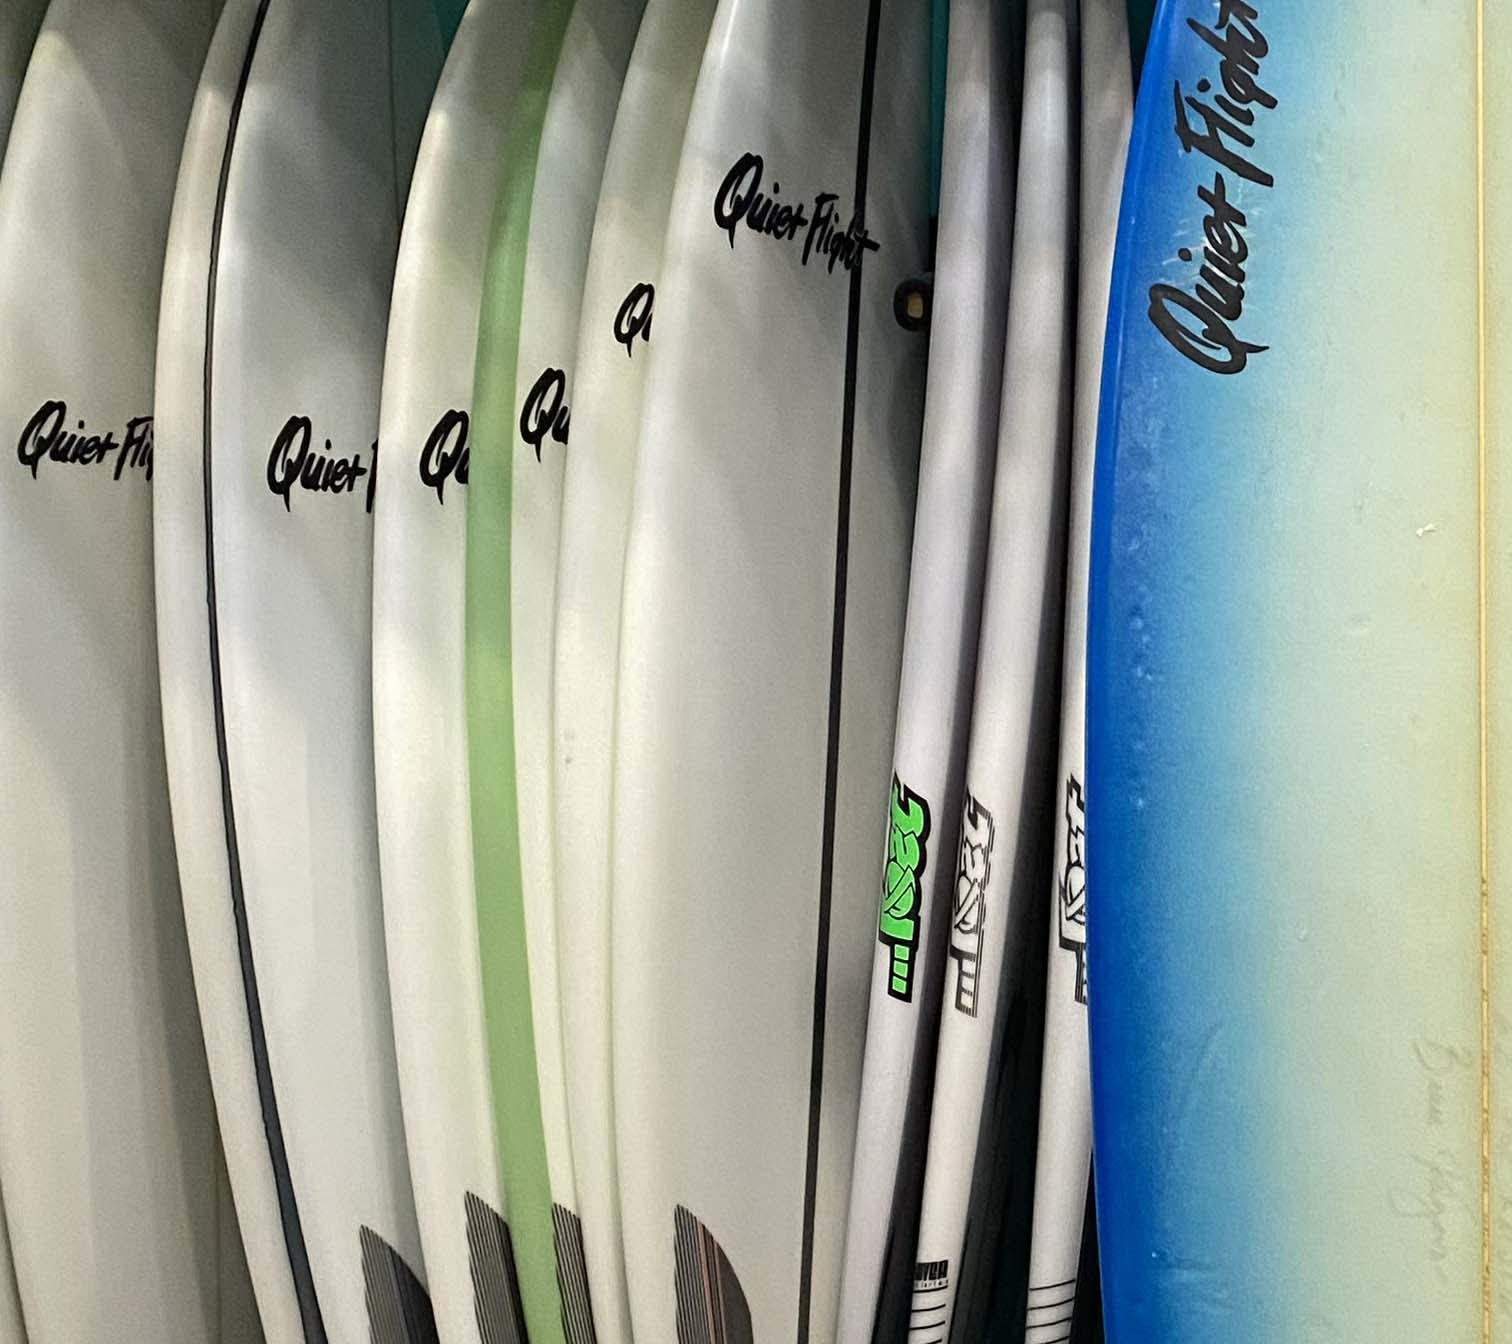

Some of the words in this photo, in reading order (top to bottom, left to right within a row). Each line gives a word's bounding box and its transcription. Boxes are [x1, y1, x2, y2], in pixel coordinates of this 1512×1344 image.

[714, 152, 808, 249] Quiet
[802, 192, 881, 275] Flight
[1148, 172, 1269, 375] Quiet
[17, 400, 119, 480] Quiet
[267, 416, 367, 512] Quiet
